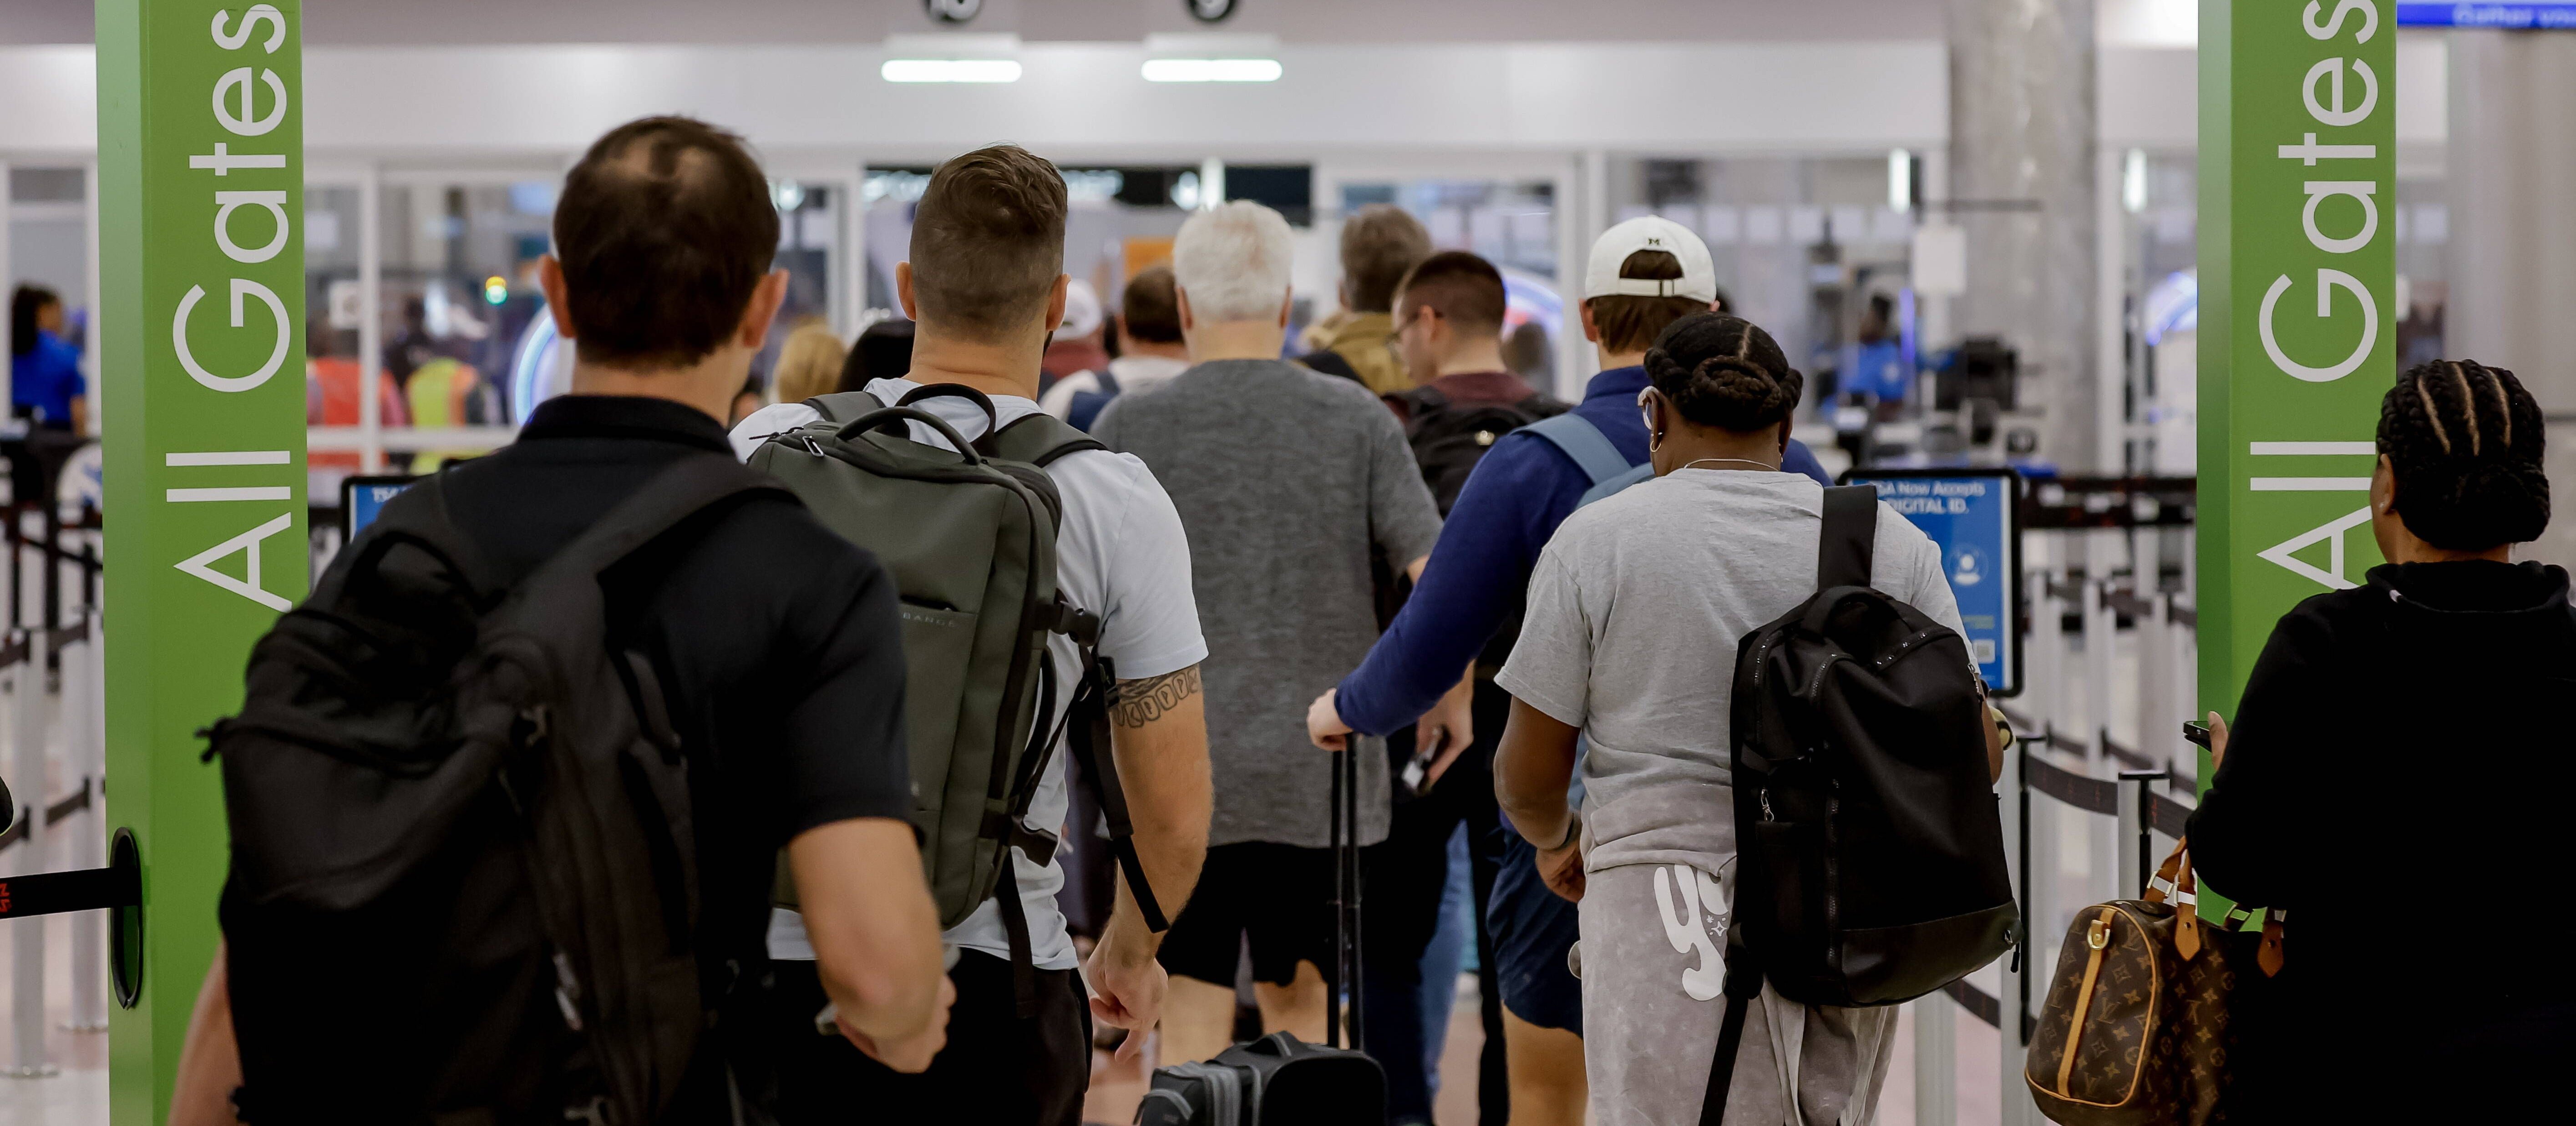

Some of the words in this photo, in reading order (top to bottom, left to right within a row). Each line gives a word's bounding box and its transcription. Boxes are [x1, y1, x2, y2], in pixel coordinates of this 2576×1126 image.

[172, 4, 291, 392] Gates
[2259, 0, 2378, 382] Gates
[165, 450, 293, 614] All
[1871, 481, 1896, 495] SA
[1897, 481, 1931, 495] Now
[1932, 481, 1986, 497] Accepts
[2250, 441, 2376, 590] All
